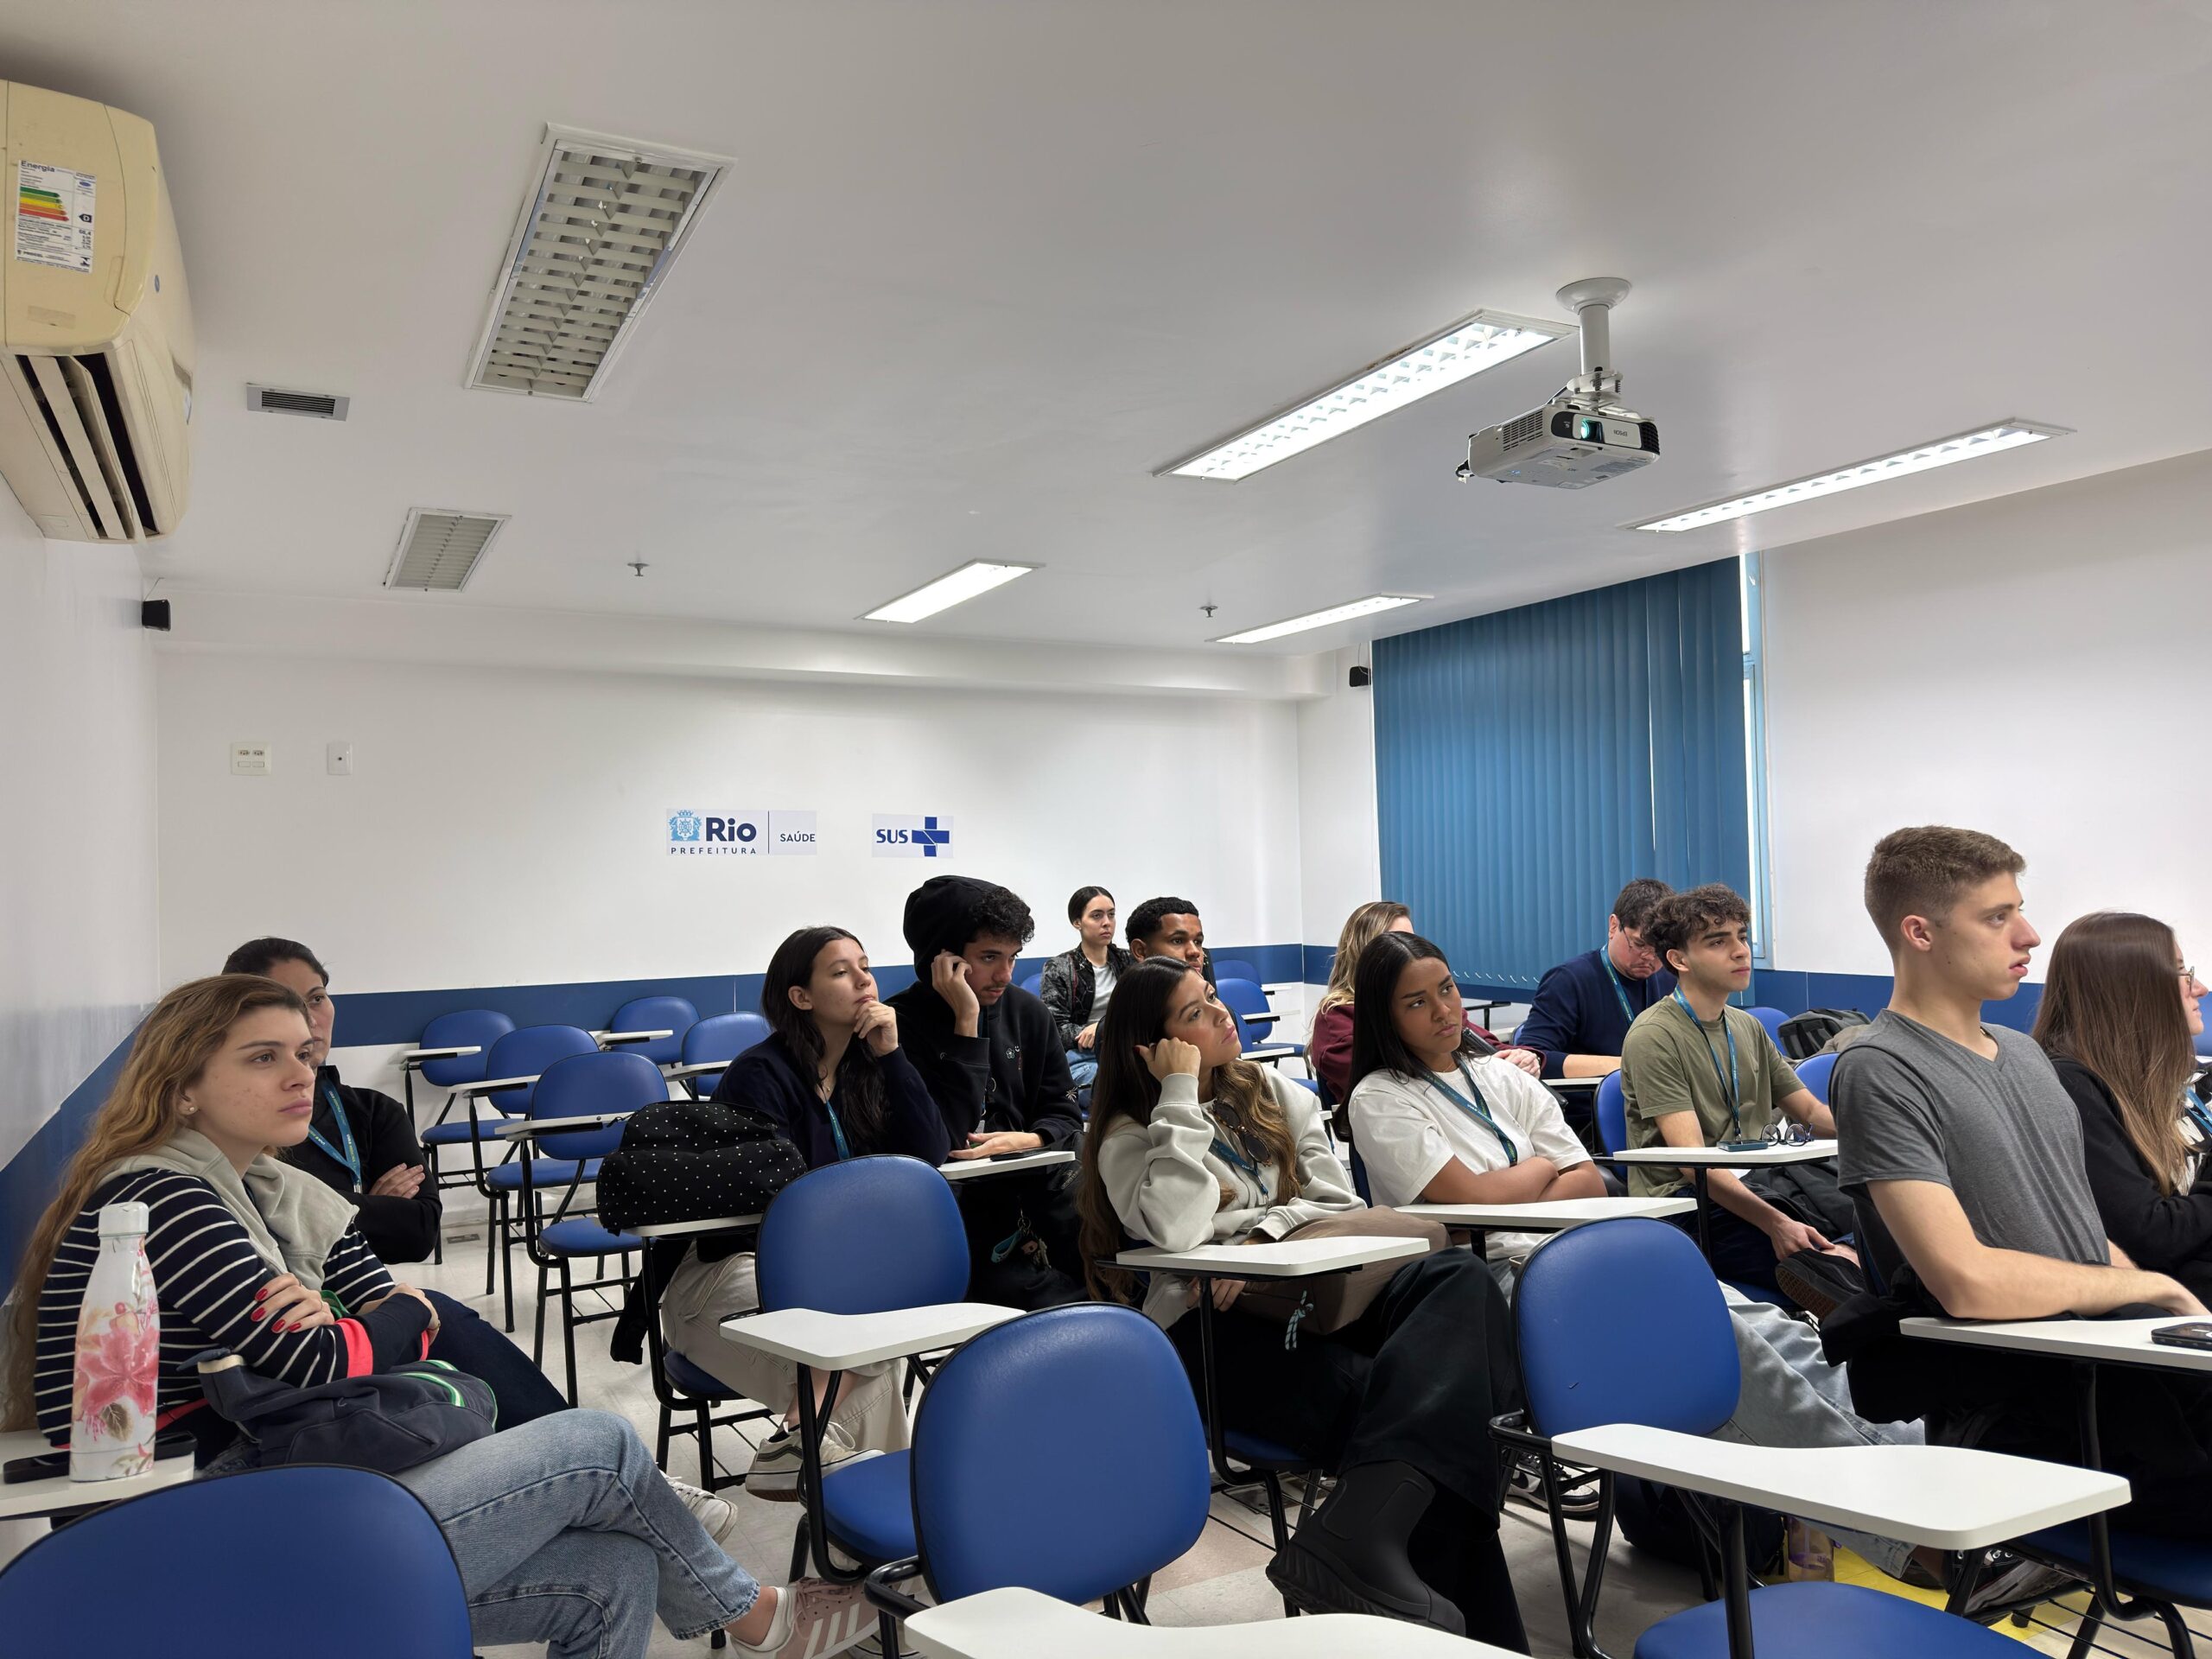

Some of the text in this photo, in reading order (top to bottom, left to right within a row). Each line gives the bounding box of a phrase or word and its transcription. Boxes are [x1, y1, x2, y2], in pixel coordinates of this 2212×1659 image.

[21, 161, 55, 172] Energia
[706, 817, 757, 842] Rio
[779, 830, 816, 842] SAÚDE
[875, 829, 909, 844] SUS
